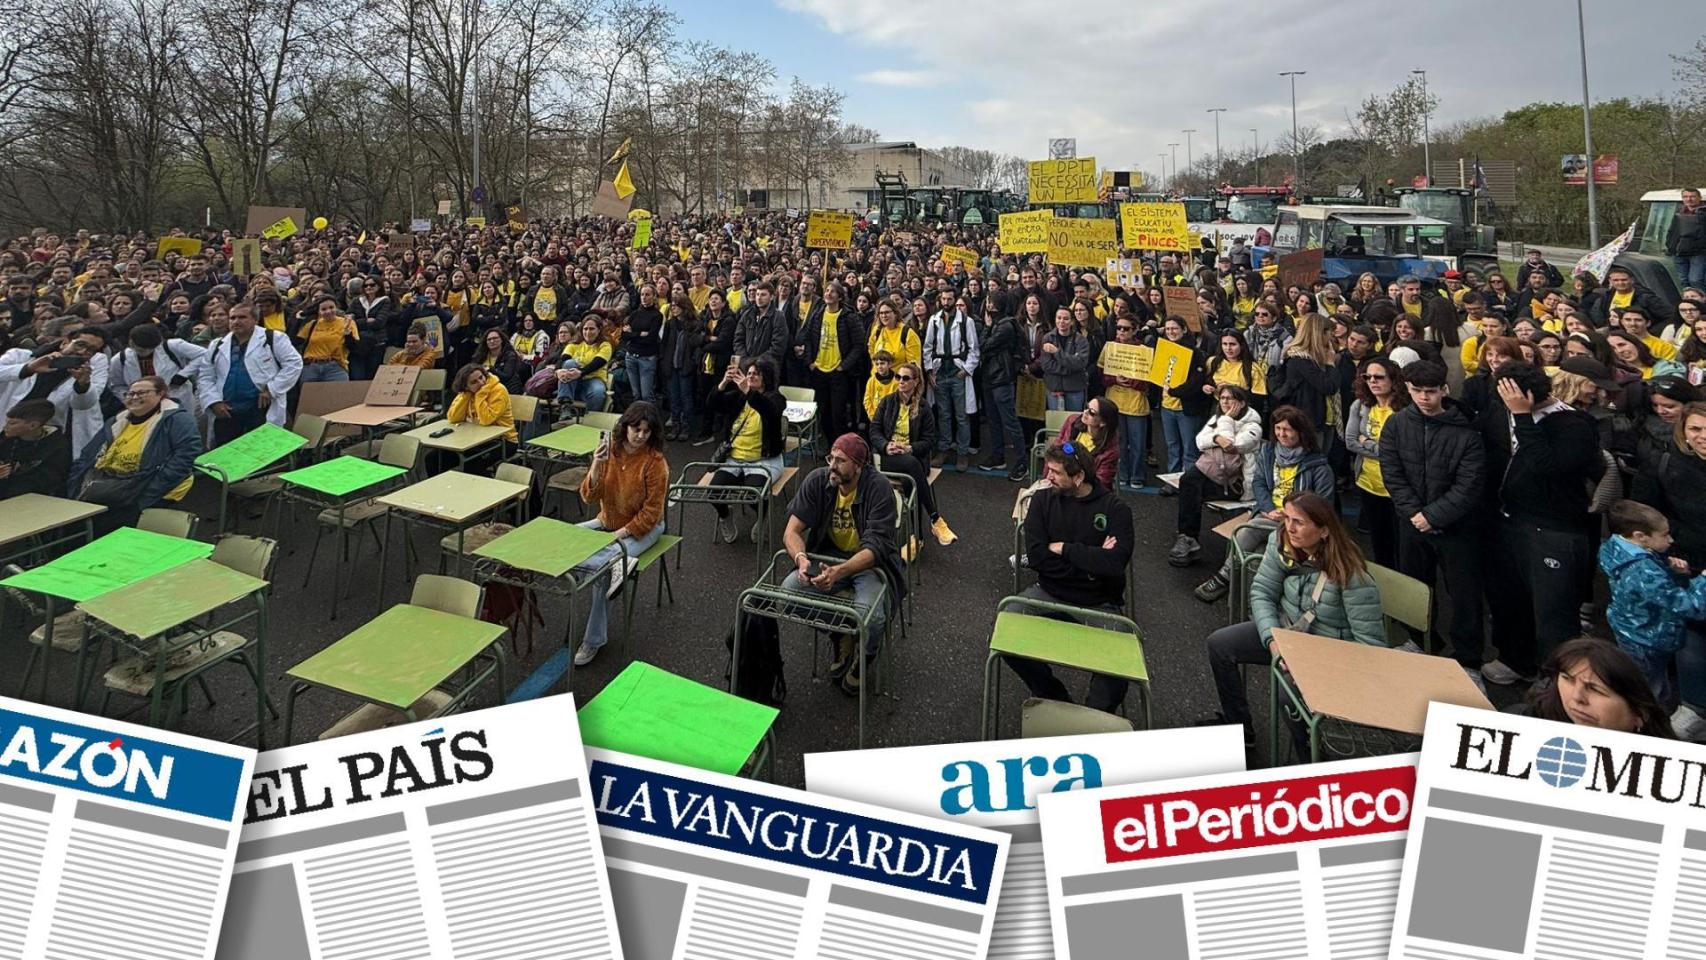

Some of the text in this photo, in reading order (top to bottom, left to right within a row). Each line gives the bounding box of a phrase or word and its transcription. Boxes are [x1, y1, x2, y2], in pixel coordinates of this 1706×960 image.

[1031, 162, 1047, 177] EL
[1030, 174, 1096, 189] NECESSITA
[1035, 188, 1055, 201] UN
[1127, 208, 1138, 217] EL
[1049, 231, 1068, 248] NO
[1097, 240, 1116, 251] SER
